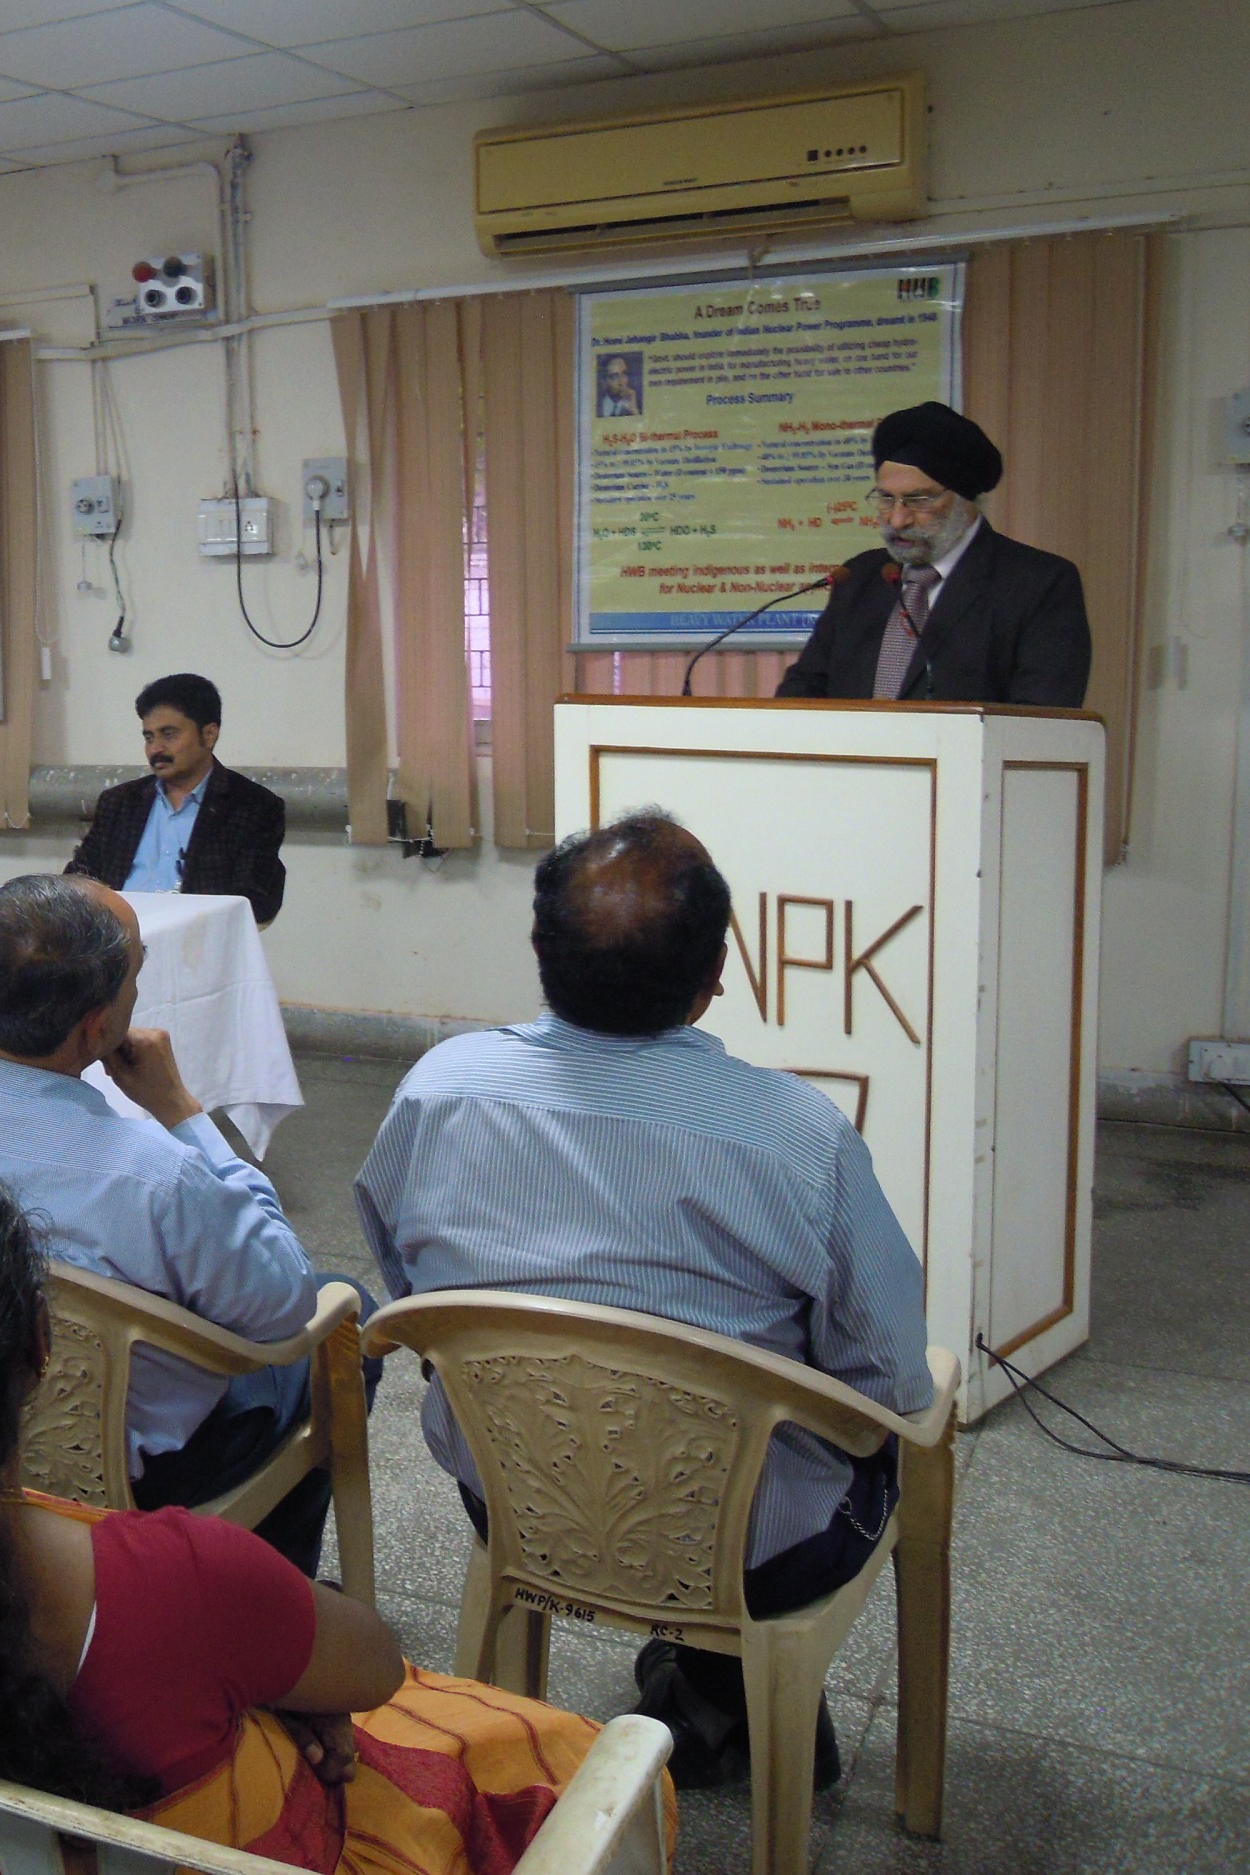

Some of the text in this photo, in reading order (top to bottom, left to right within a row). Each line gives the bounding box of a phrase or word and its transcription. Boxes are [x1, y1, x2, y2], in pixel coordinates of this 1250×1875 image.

[694, 298, 821, 319] A Dream Comes True
[796, 322, 822, 332] Power
[706, 392, 793, 405] Process Summary
[648, 565, 689, 579] meeting
[676, 582, 717, 594] Nuclear
[730, 581, 794, 593] Non-Nuclear
[515, 1587, 596, 1622] HWP/K-9615
